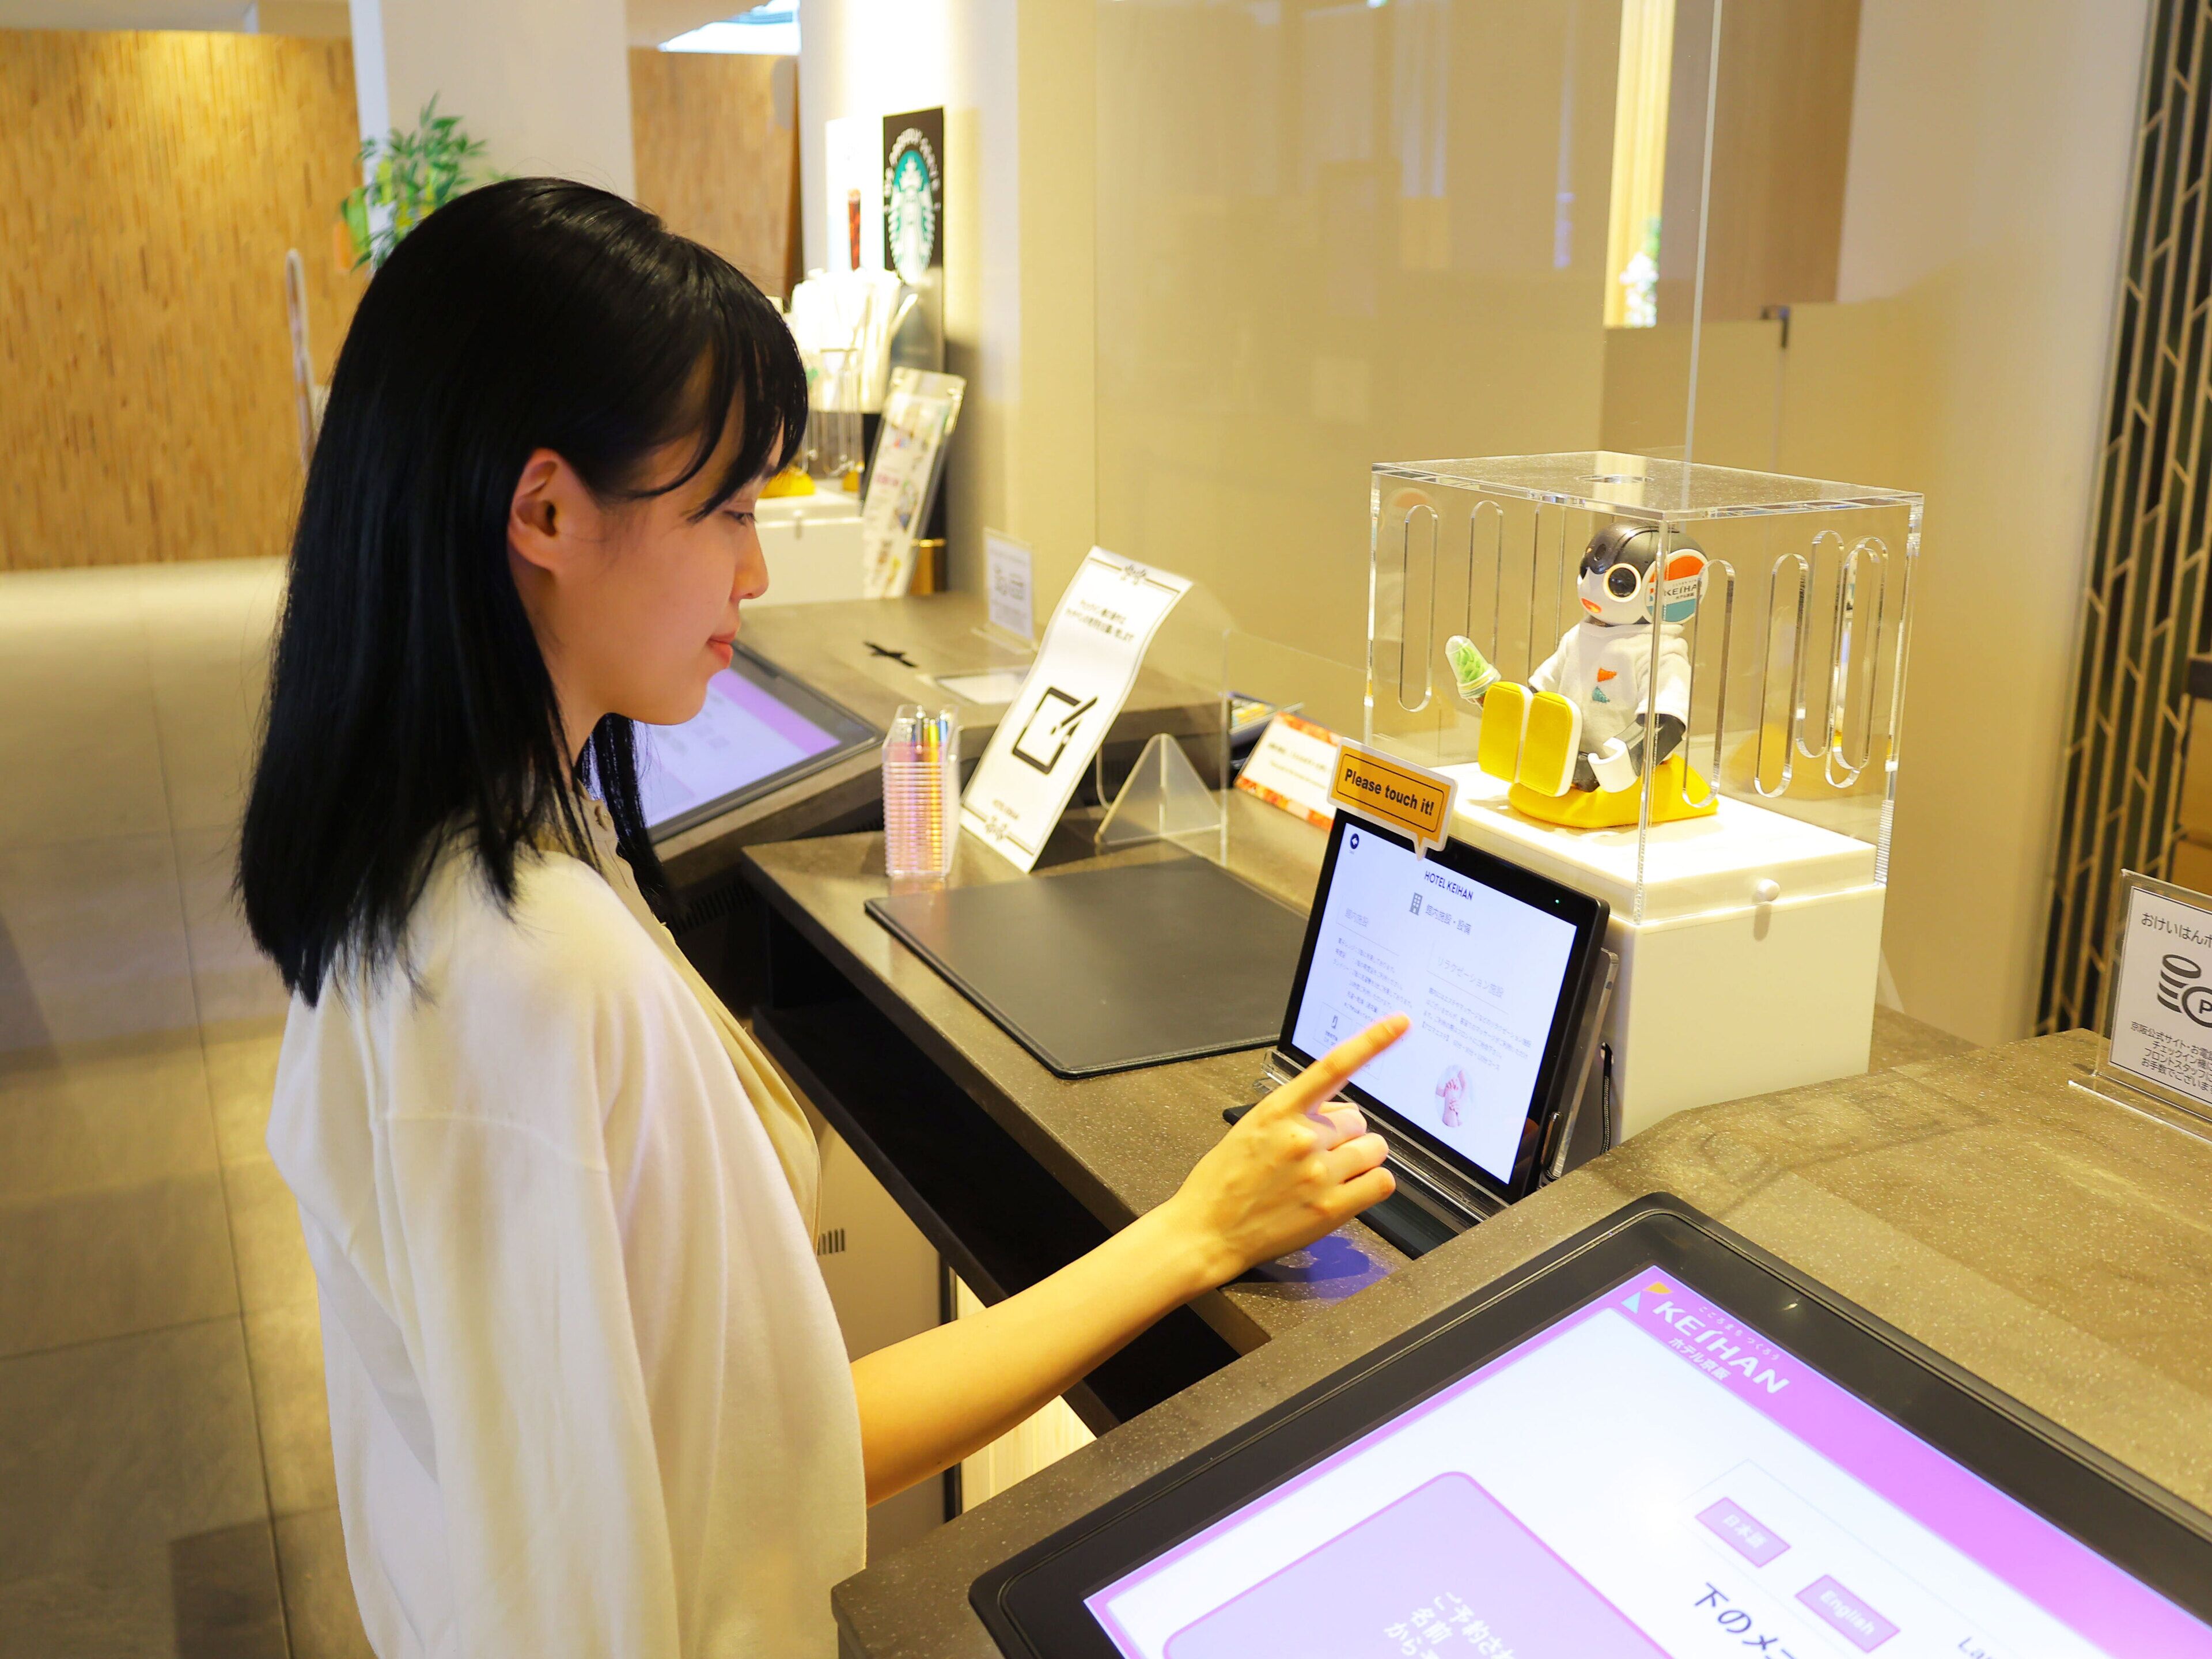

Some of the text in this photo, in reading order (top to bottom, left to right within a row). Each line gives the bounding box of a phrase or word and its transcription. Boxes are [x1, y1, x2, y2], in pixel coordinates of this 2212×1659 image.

[1664, 581, 1702, 597] KEIHA
[1344, 768, 1381, 795] Please
[1385, 785, 1418, 809] touch
[1421, 798, 1434, 816] it!
[1424, 870, 1474, 902] HOTEL KEIHAN
[2141, 1058, 2212, 1094] お手数でございま
[1652, 1301, 1790, 1395] KEIHAN
[1668, 1337, 1732, 1382] ホテル京阪
[1722, 1513, 1766, 1549] 日本語
[1410, 1607, 1453, 1645] 名前
[1820, 1589, 1875, 1636] English
